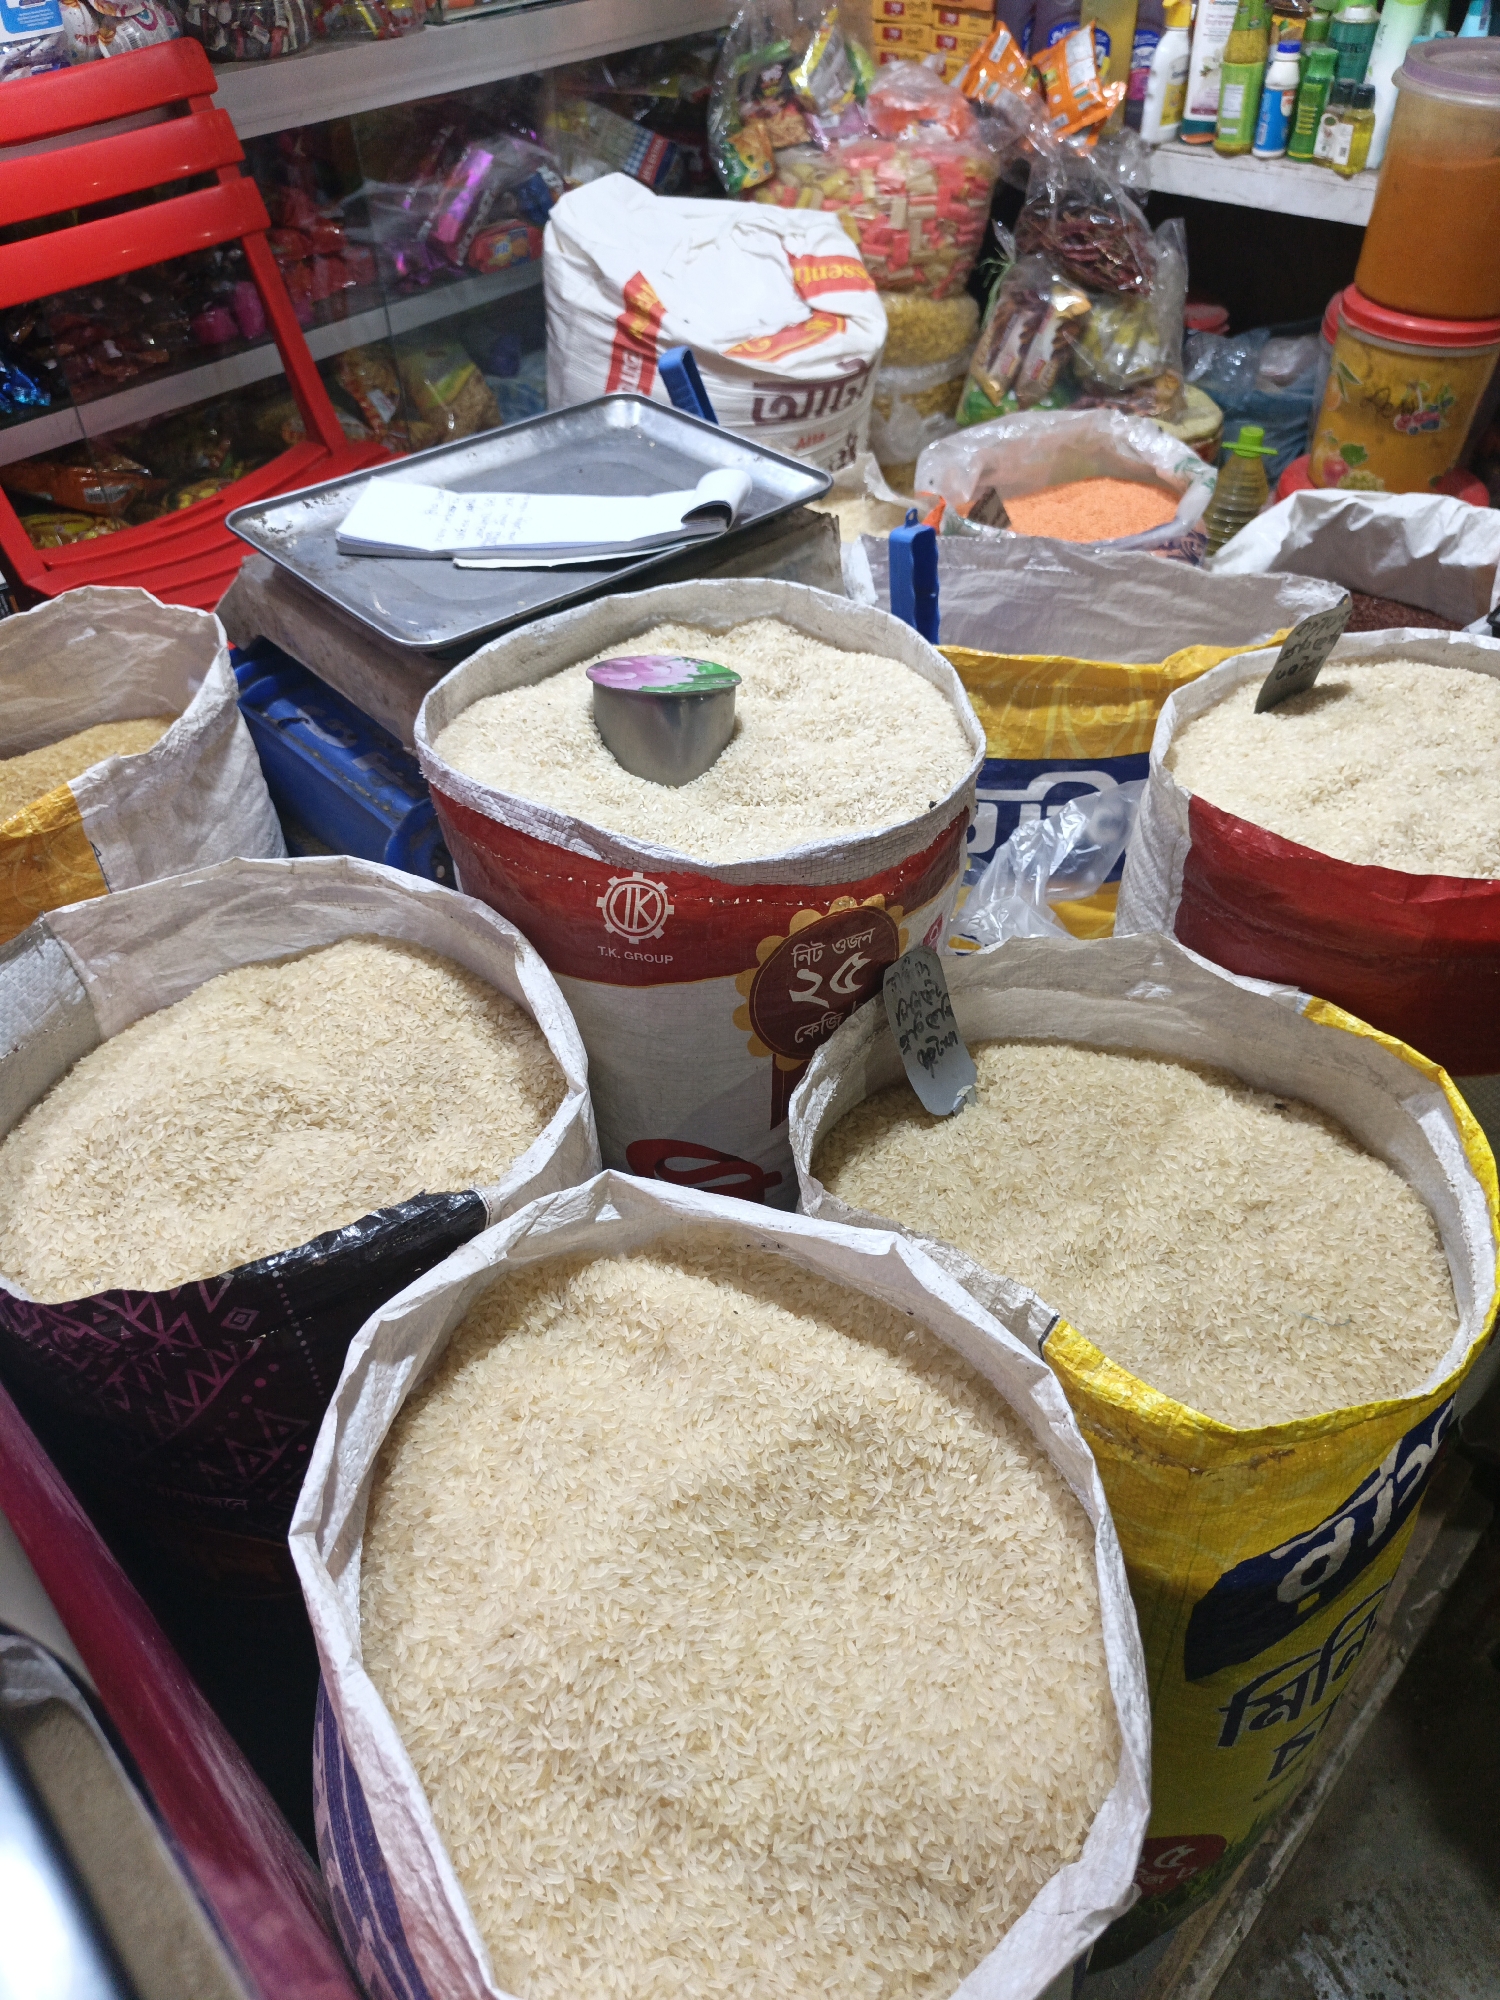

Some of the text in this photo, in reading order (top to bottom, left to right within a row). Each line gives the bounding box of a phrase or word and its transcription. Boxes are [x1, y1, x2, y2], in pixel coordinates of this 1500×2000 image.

[793, 263, 877, 287] ssenti
[597, 945, 674, 965] T.K. GROUP
[790, 927, 876, 968] নিট ওজন
[788, 951, 872, 1009] ২৫
[794, 1011, 845, 1044] কেজি
